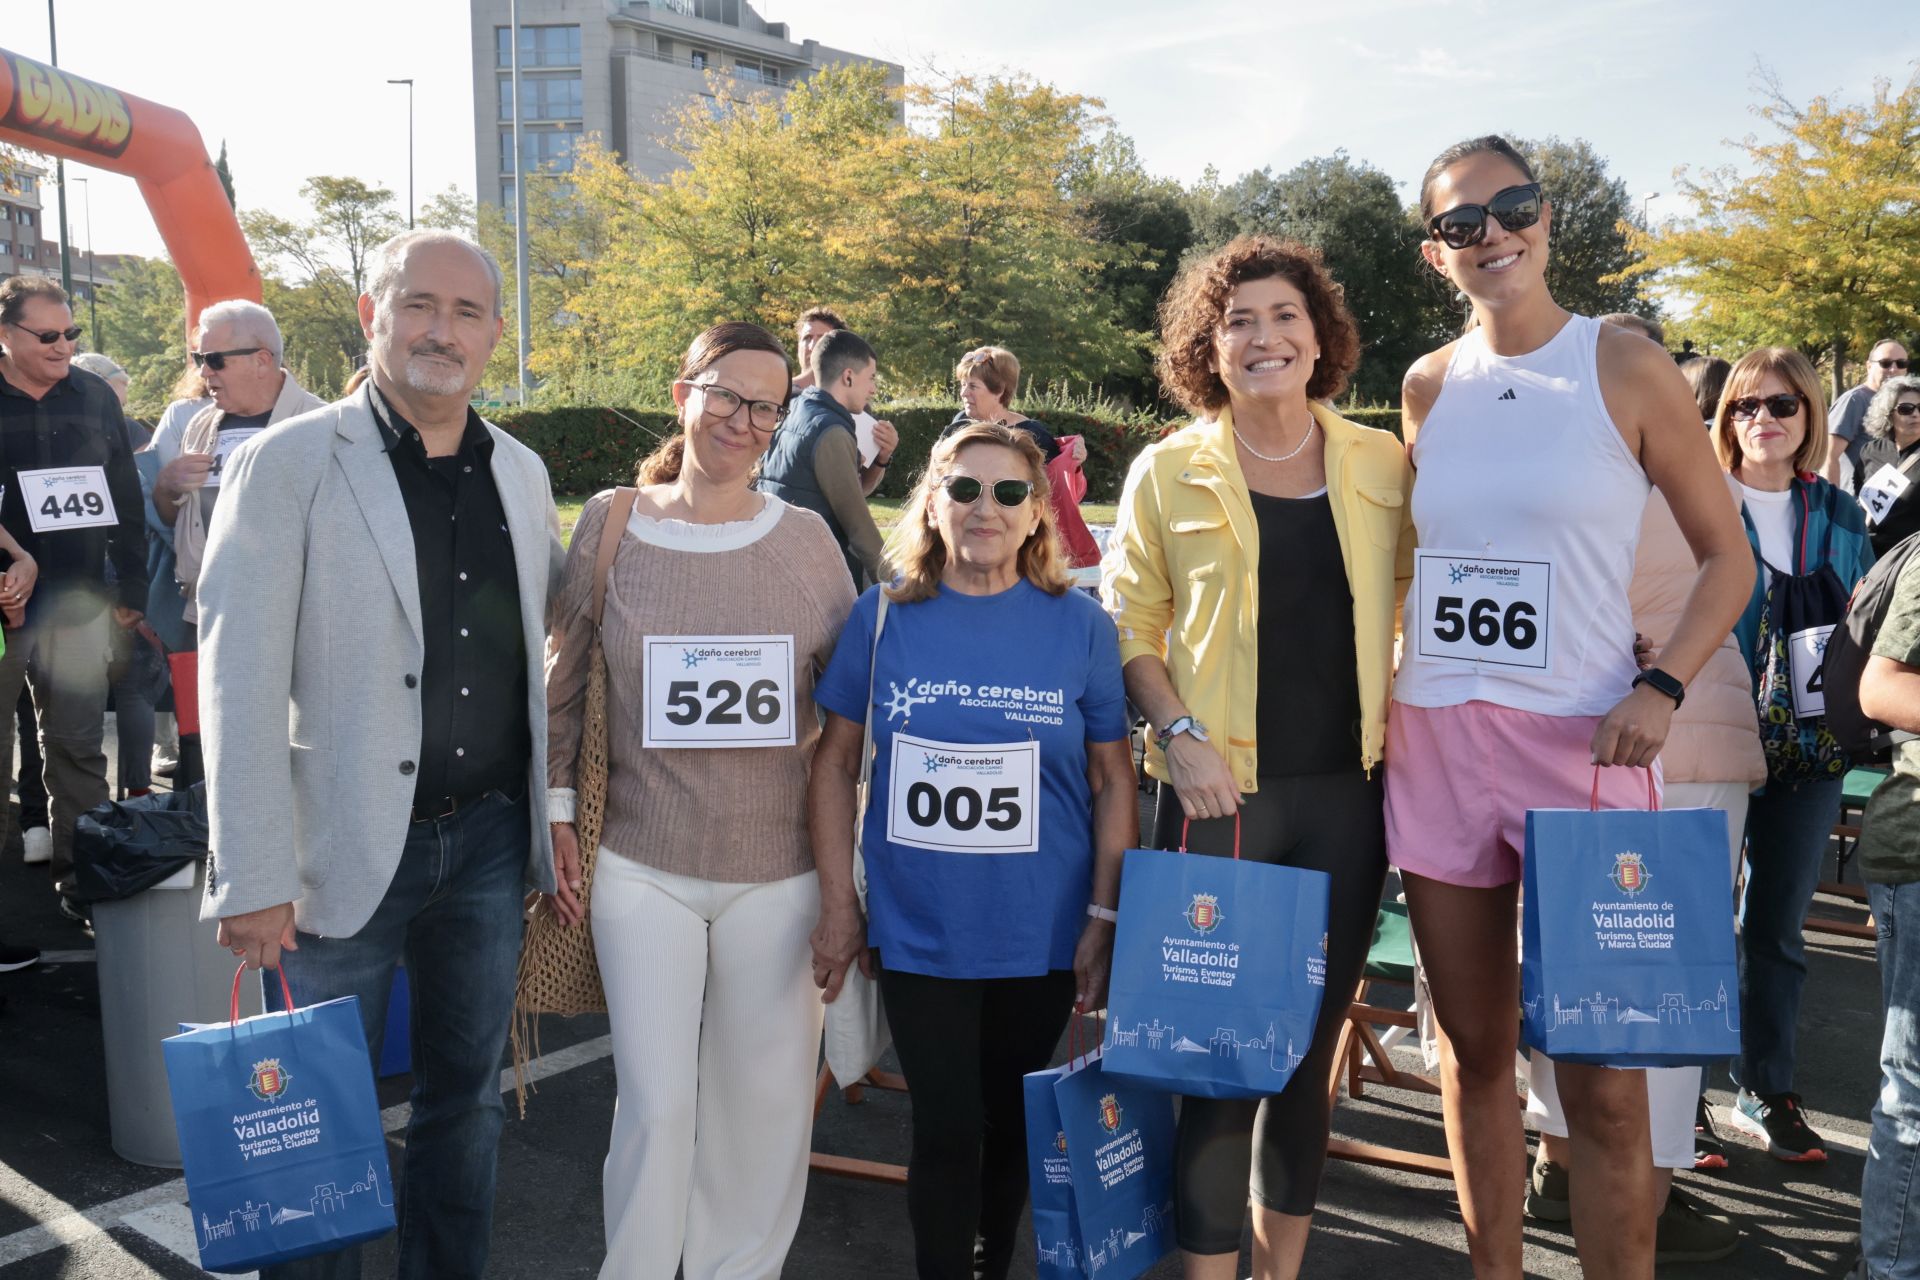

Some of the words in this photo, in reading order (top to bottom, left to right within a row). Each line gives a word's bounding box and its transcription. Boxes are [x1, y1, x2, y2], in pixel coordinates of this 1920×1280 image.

[14, 58, 130, 146] GADIS
[41, 492, 104, 519] 449
[1871, 479, 1898, 513] 411
[1463, 564, 1484, 574] daño
[1486, 567, 1520, 576] cerebral
[1434, 596, 1537, 650] 566
[698, 648, 722, 656] daño
[724, 648, 762, 656] cerebral
[666, 678, 780, 726] 526
[916, 680, 972, 696] daño
[978, 686, 1064, 705] cerebral
[960, 698, 1022, 710] ASOCIACIÓN
[1025, 703, 1064, 714] CAMINO
[1004, 712, 1063, 726] VALLADOLID
[938, 756, 962, 764] daño
[964, 757, 1004, 765] cerebral
[906, 782, 1022, 832] 005
[1592, 902, 1658, 912] Ayuntamiento
[1662, 902, 1674, 910] de
[1592, 914, 1674, 928] Valladolid
[1163, 936, 1226, 950] Ayuntamiento
[1228, 942, 1240, 951] de
[1595, 932, 1635, 941] Turismo,
[1637, 932, 1674, 940] Eventos
[1599, 941, 1604, 950] y
[1608, 940, 1636, 948] Marca
[1639, 940, 1671, 948] Ciudad
[1162, 946, 1238, 968] Valladolid
[1162, 964, 1198, 976] Turismo,
[1200, 968, 1236, 980] Eventos
[1172, 973, 1198, 983] Marca
[1201, 976, 1232, 986] Ciudad
[1306, 964, 1326, 974] Valla
[232, 1102, 302, 1124] Ayuntamiento
[304, 1098, 317, 1108] de
[234, 1108, 320, 1140] Valladolid
[238, 1137, 280, 1152] Turismo,
[282, 1127, 320, 1142] Eventos
[244, 1152, 249, 1160] y
[252, 1145, 282, 1158] Marca
[284, 1134, 318, 1149] Ciudad
[1095, 1132, 1132, 1158] Ayuntamiento
[1132, 1128, 1139, 1136] de
[1096, 1137, 1143, 1172] Valladolid
[1124, 1155, 1144, 1170] Eventos
[1108, 1174, 1125, 1187] Marca
[1125, 1162, 1144, 1176] Ciudad
